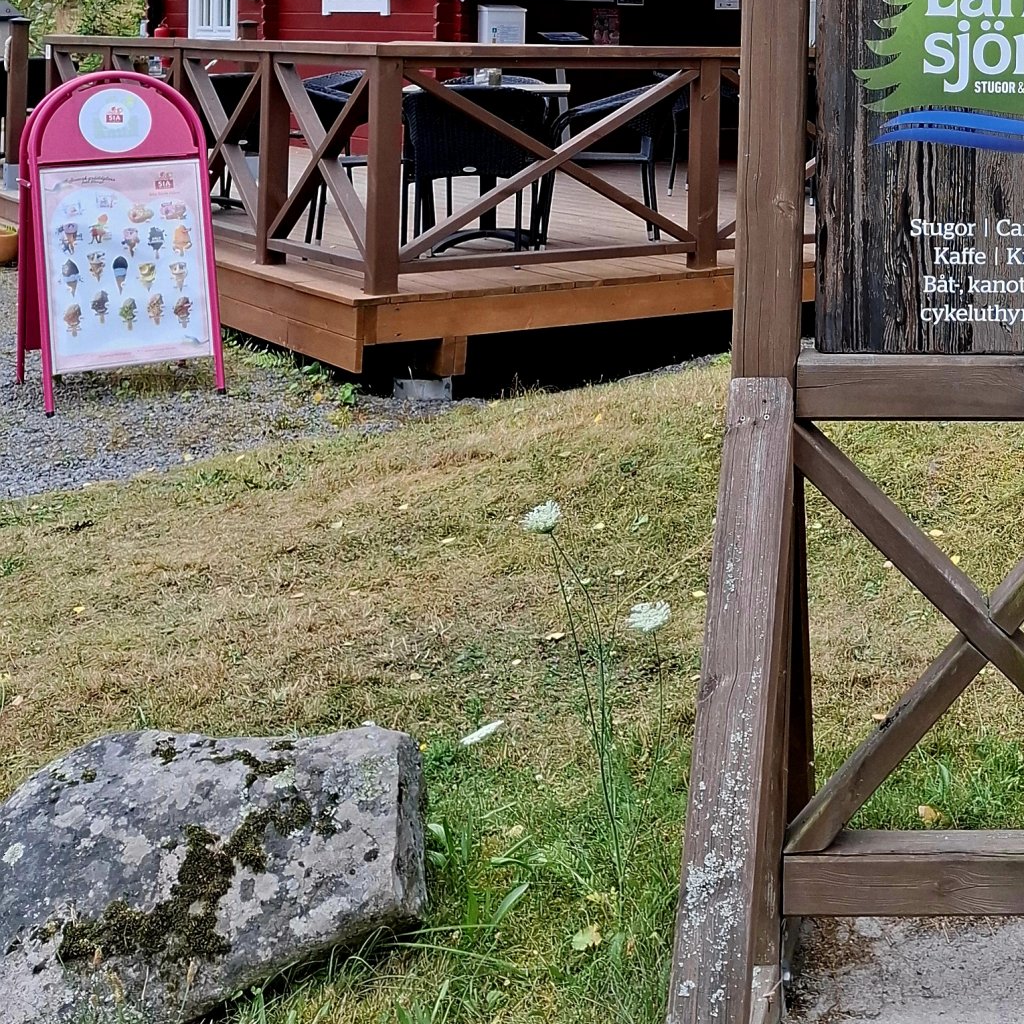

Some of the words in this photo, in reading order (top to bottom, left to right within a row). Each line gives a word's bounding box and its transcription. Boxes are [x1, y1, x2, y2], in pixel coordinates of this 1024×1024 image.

[974, 81, 1016, 94] STUGOR
[910, 219, 977, 240] Stugor
[933, 247, 987, 265] Kaffe
[923, 274, 964, 295] Båt-,
